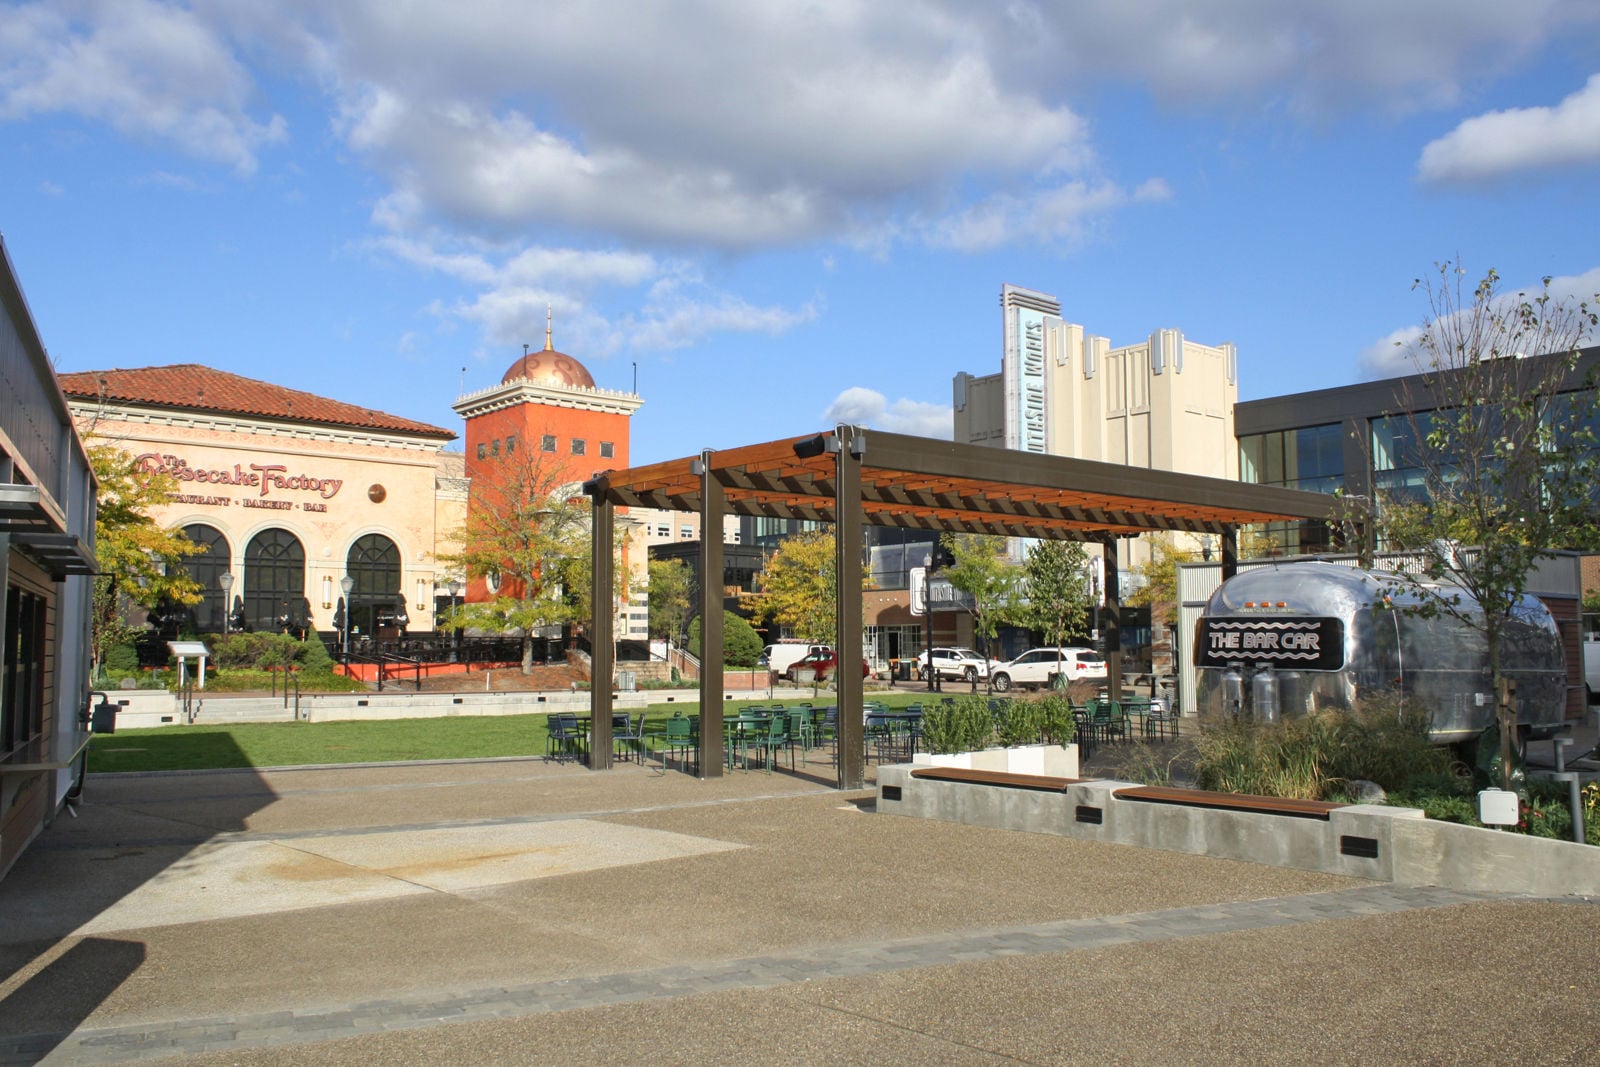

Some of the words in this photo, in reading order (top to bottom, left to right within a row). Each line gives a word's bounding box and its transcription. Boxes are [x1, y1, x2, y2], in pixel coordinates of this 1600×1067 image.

[1024, 319, 1042, 377] WORKS
[162, 454, 187, 467] The
[249, 463, 343, 499] Factory
[242, 499, 293, 511] BAKERY
[303, 502, 327, 513] BAR
[1209, 632, 1240, 649] THE
[1243, 632, 1279, 649] BAR
[1281, 632, 1320, 650] CAR
